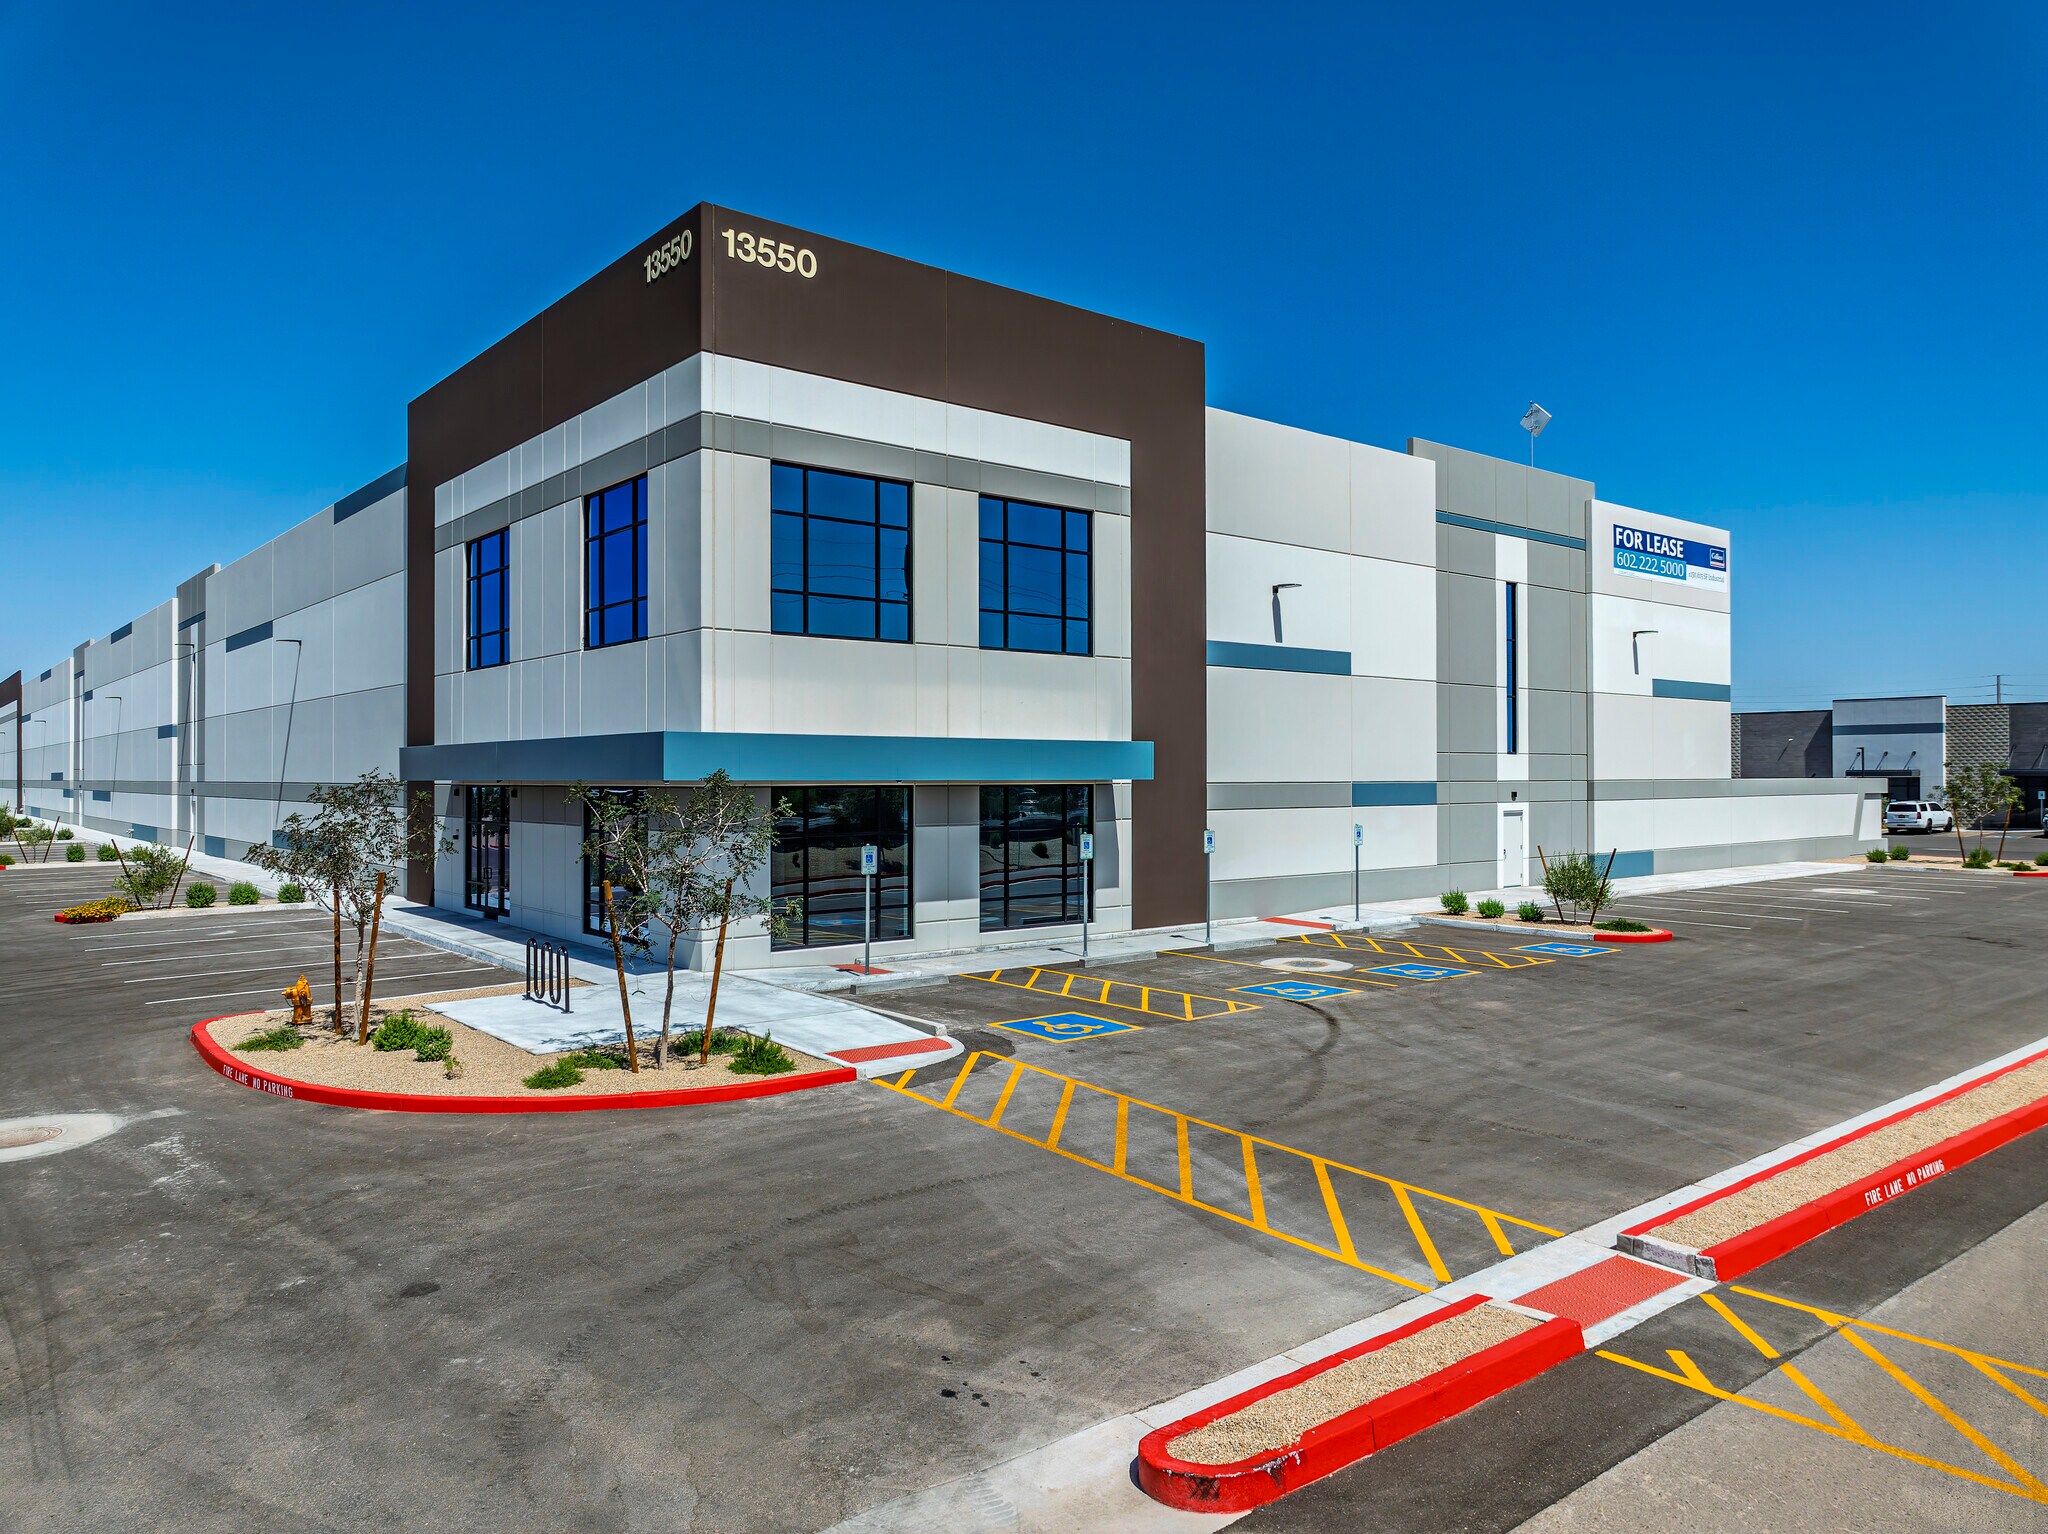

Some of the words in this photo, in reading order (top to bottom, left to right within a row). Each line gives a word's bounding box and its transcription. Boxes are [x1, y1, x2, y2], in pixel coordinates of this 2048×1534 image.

[644, 229, 692, 283] 13550
[721, 228, 818, 279] 13550
[1615, 527, 1643, 551] FOR
[1646, 534, 1684, 558] LEASE
[223, 1064, 234, 1078] FIRE
[235, 1070, 249, 1085] LANE
[252, 1077, 261, 1089] NO
[263, 1080, 293, 1098] PARKING
[1864, 1187, 1883, 1207] FIRE
[1884, 1178, 1904, 1198] LANE
[1906, 1171, 1917, 1186] NO
[1916, 1159, 1945, 1181] PARKING
